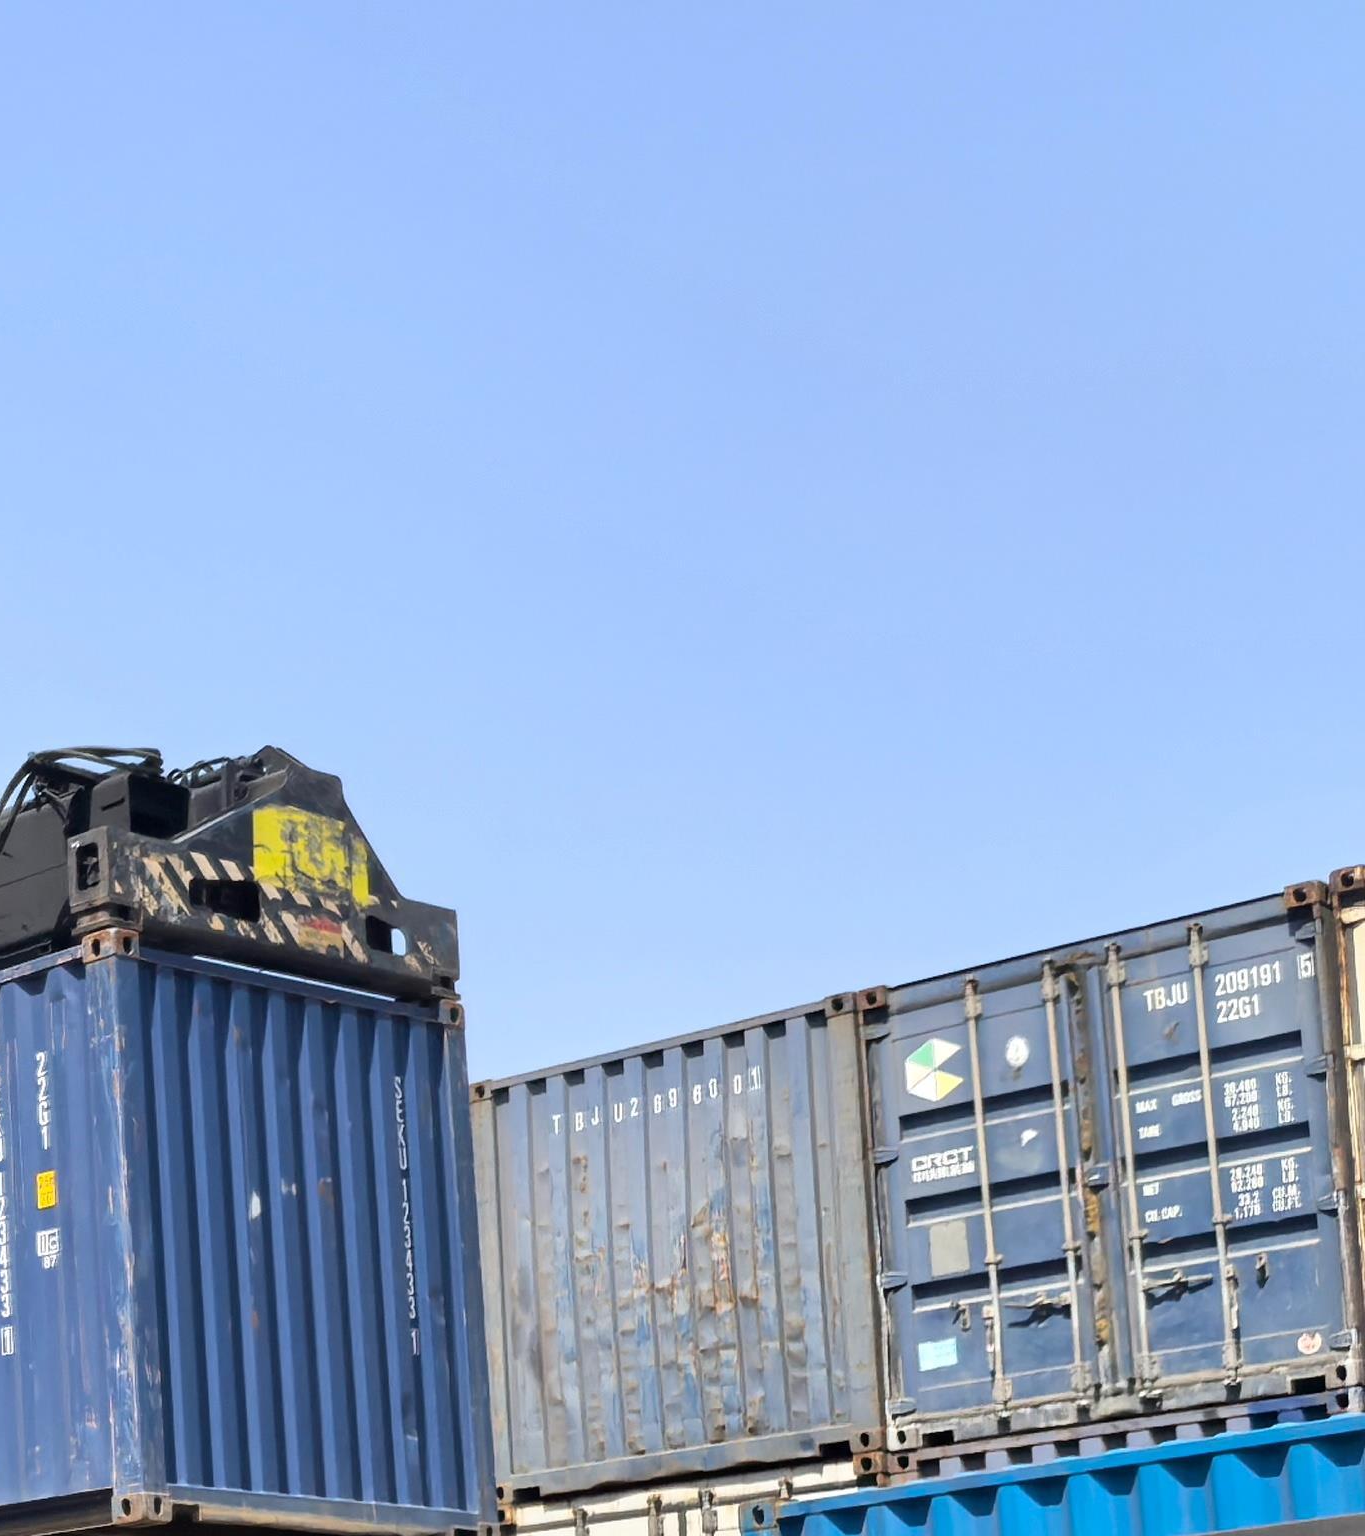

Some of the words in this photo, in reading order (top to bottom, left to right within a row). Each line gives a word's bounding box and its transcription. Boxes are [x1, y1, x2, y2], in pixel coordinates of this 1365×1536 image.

[1143, 981, 1189, 1012] TBJU
[1214, 960, 1281, 997] 209191
[1299, 953, 1314, 978] 5
[1216, 994, 1260, 1024] 22G1
[35, 1051, 51, 1150] 22G1
[393, 1075, 408, 1171] SEKU
[401, 1178, 416, 1320] 123433
[2, 1327, 13, 1355] 1
